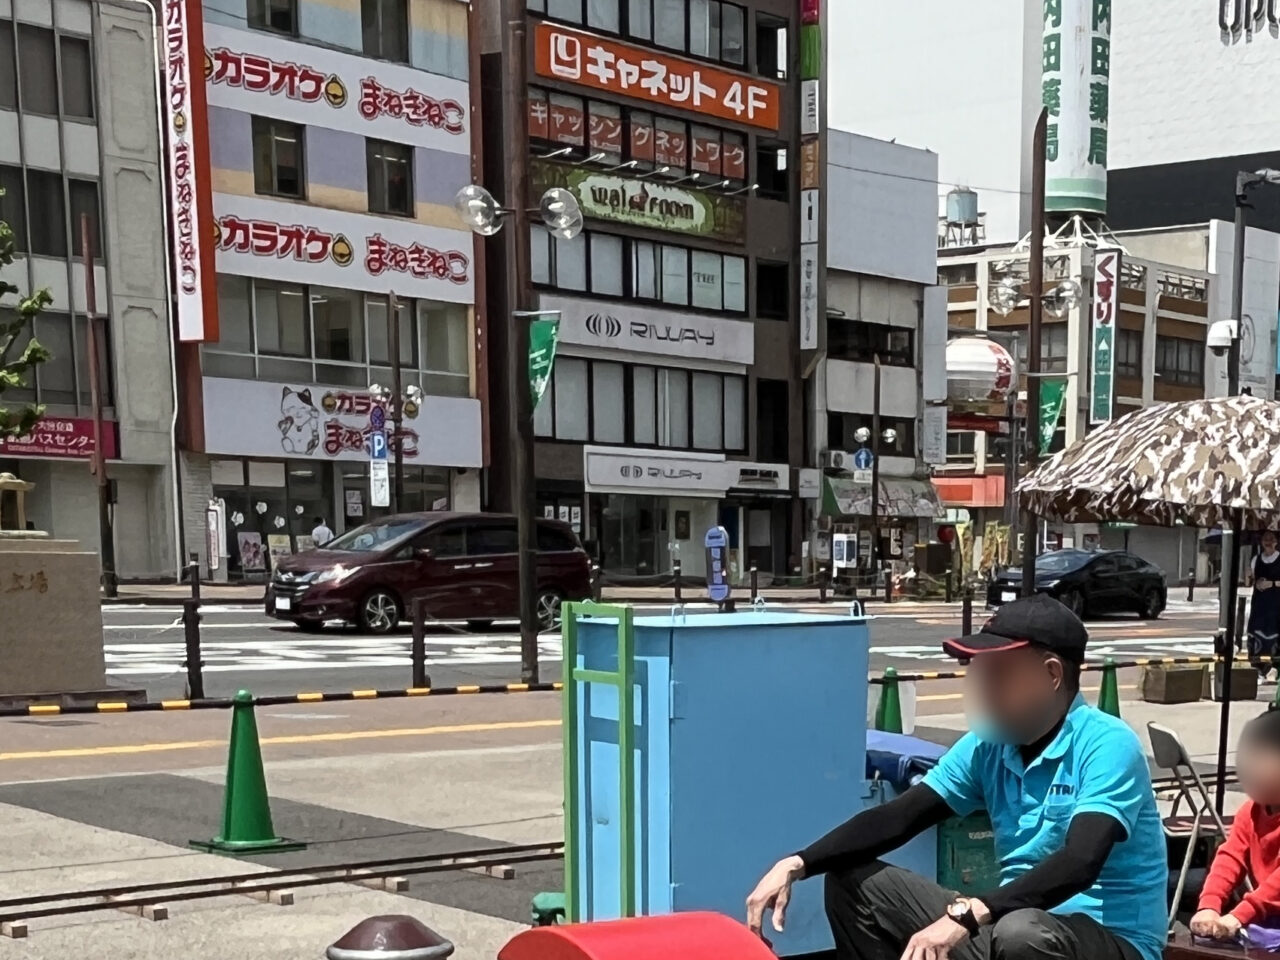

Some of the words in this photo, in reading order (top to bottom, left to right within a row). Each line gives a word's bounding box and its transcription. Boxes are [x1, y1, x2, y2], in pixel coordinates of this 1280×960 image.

[165, 0, 188, 110] カラオケ
[586, 46, 716, 107] キャネット
[723, 81, 768, 119] 4F
[212, 48, 327, 102] カラオケ
[359, 77, 466, 135] まねきねこ
[531, 102, 745, 166] キャッシングネットワーク
[219, 216, 333, 263] カラオケ
[364, 234, 469, 284] まねきねこ
[1097, 254, 1115, 325] くすり
[373, 435, 384, 456] P
